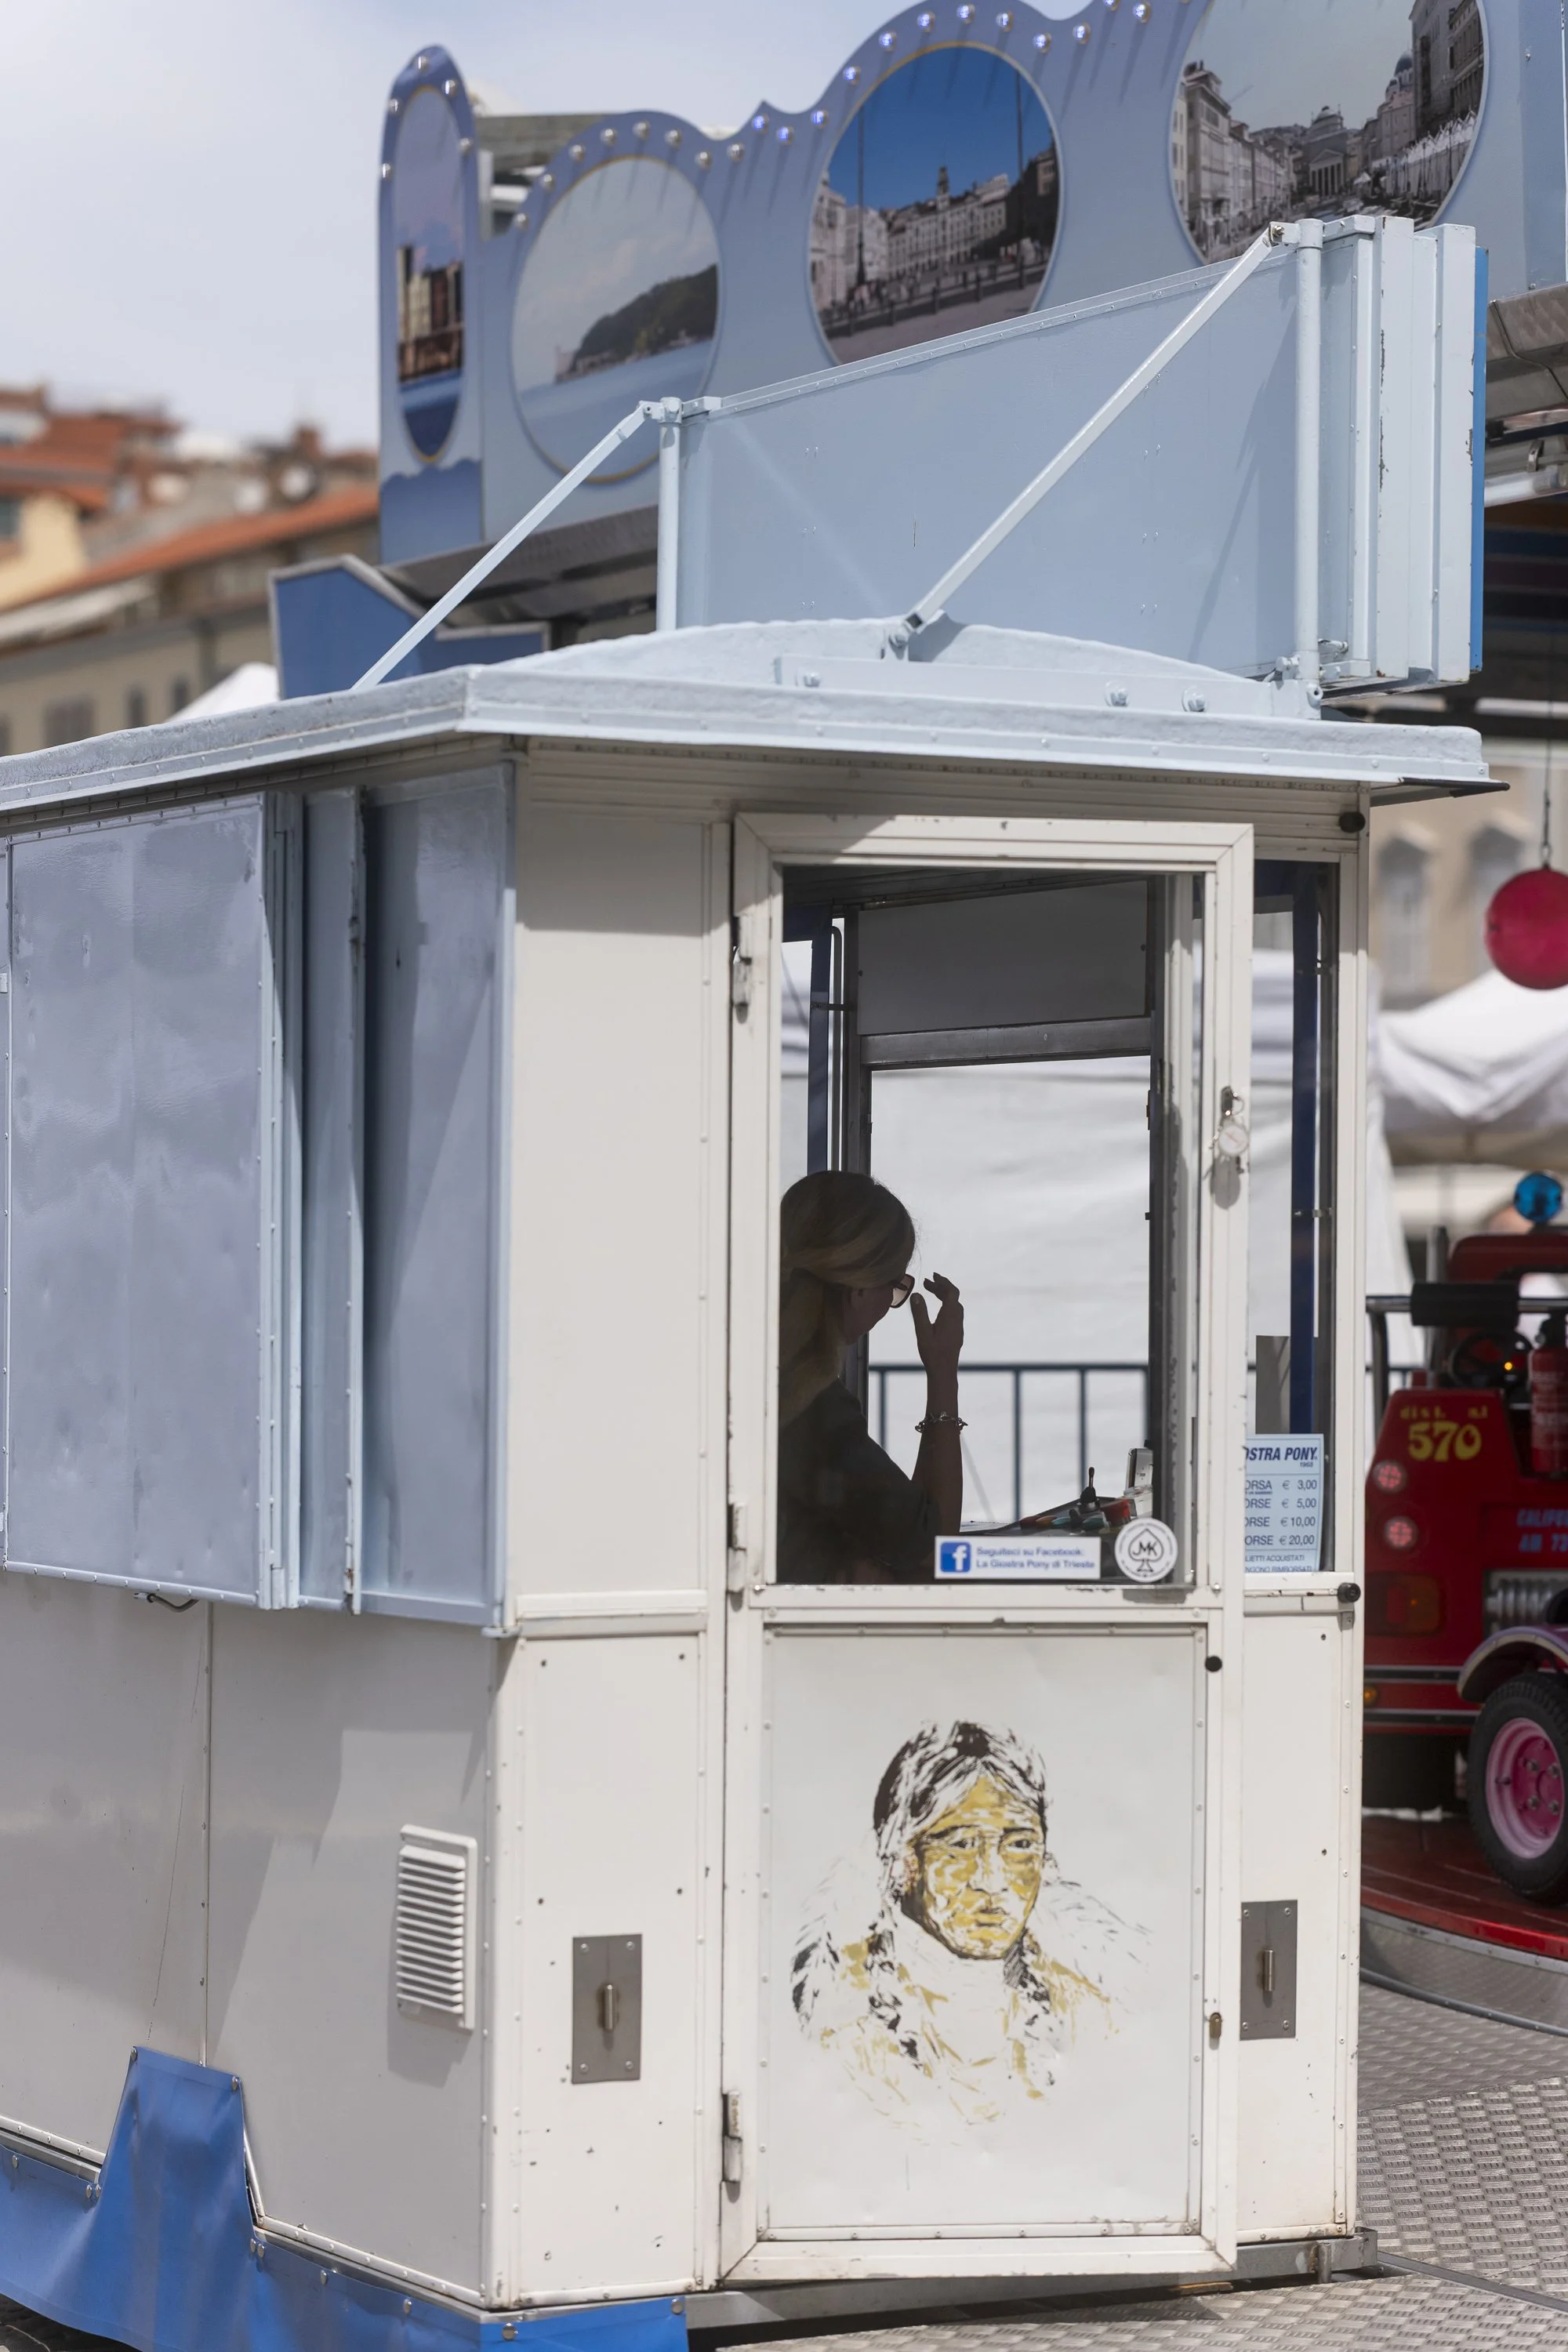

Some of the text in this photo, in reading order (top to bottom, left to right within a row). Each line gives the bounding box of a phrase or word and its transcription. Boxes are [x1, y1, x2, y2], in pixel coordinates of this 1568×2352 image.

[1408, 1420, 1483, 1462] 570
[1284, 1446, 1318, 1461] PONY
[1282, 1479, 1290, 1490] €
[1297, 1479, 1317, 1491] 3,00
[1281, 1498, 1289, 1508] €
[1296, 1497, 1317, 1509] 5,00
[1280, 1516, 1288, 1526] €
[1290, 1516, 1316, 1527] 10,00
[1279, 1534, 1287, 1545] €
[1288, 1534, 1315, 1546] 20,00
[1132, 1541, 1158, 1556] JMK
[1027, 1560, 1049, 1570] Pony
